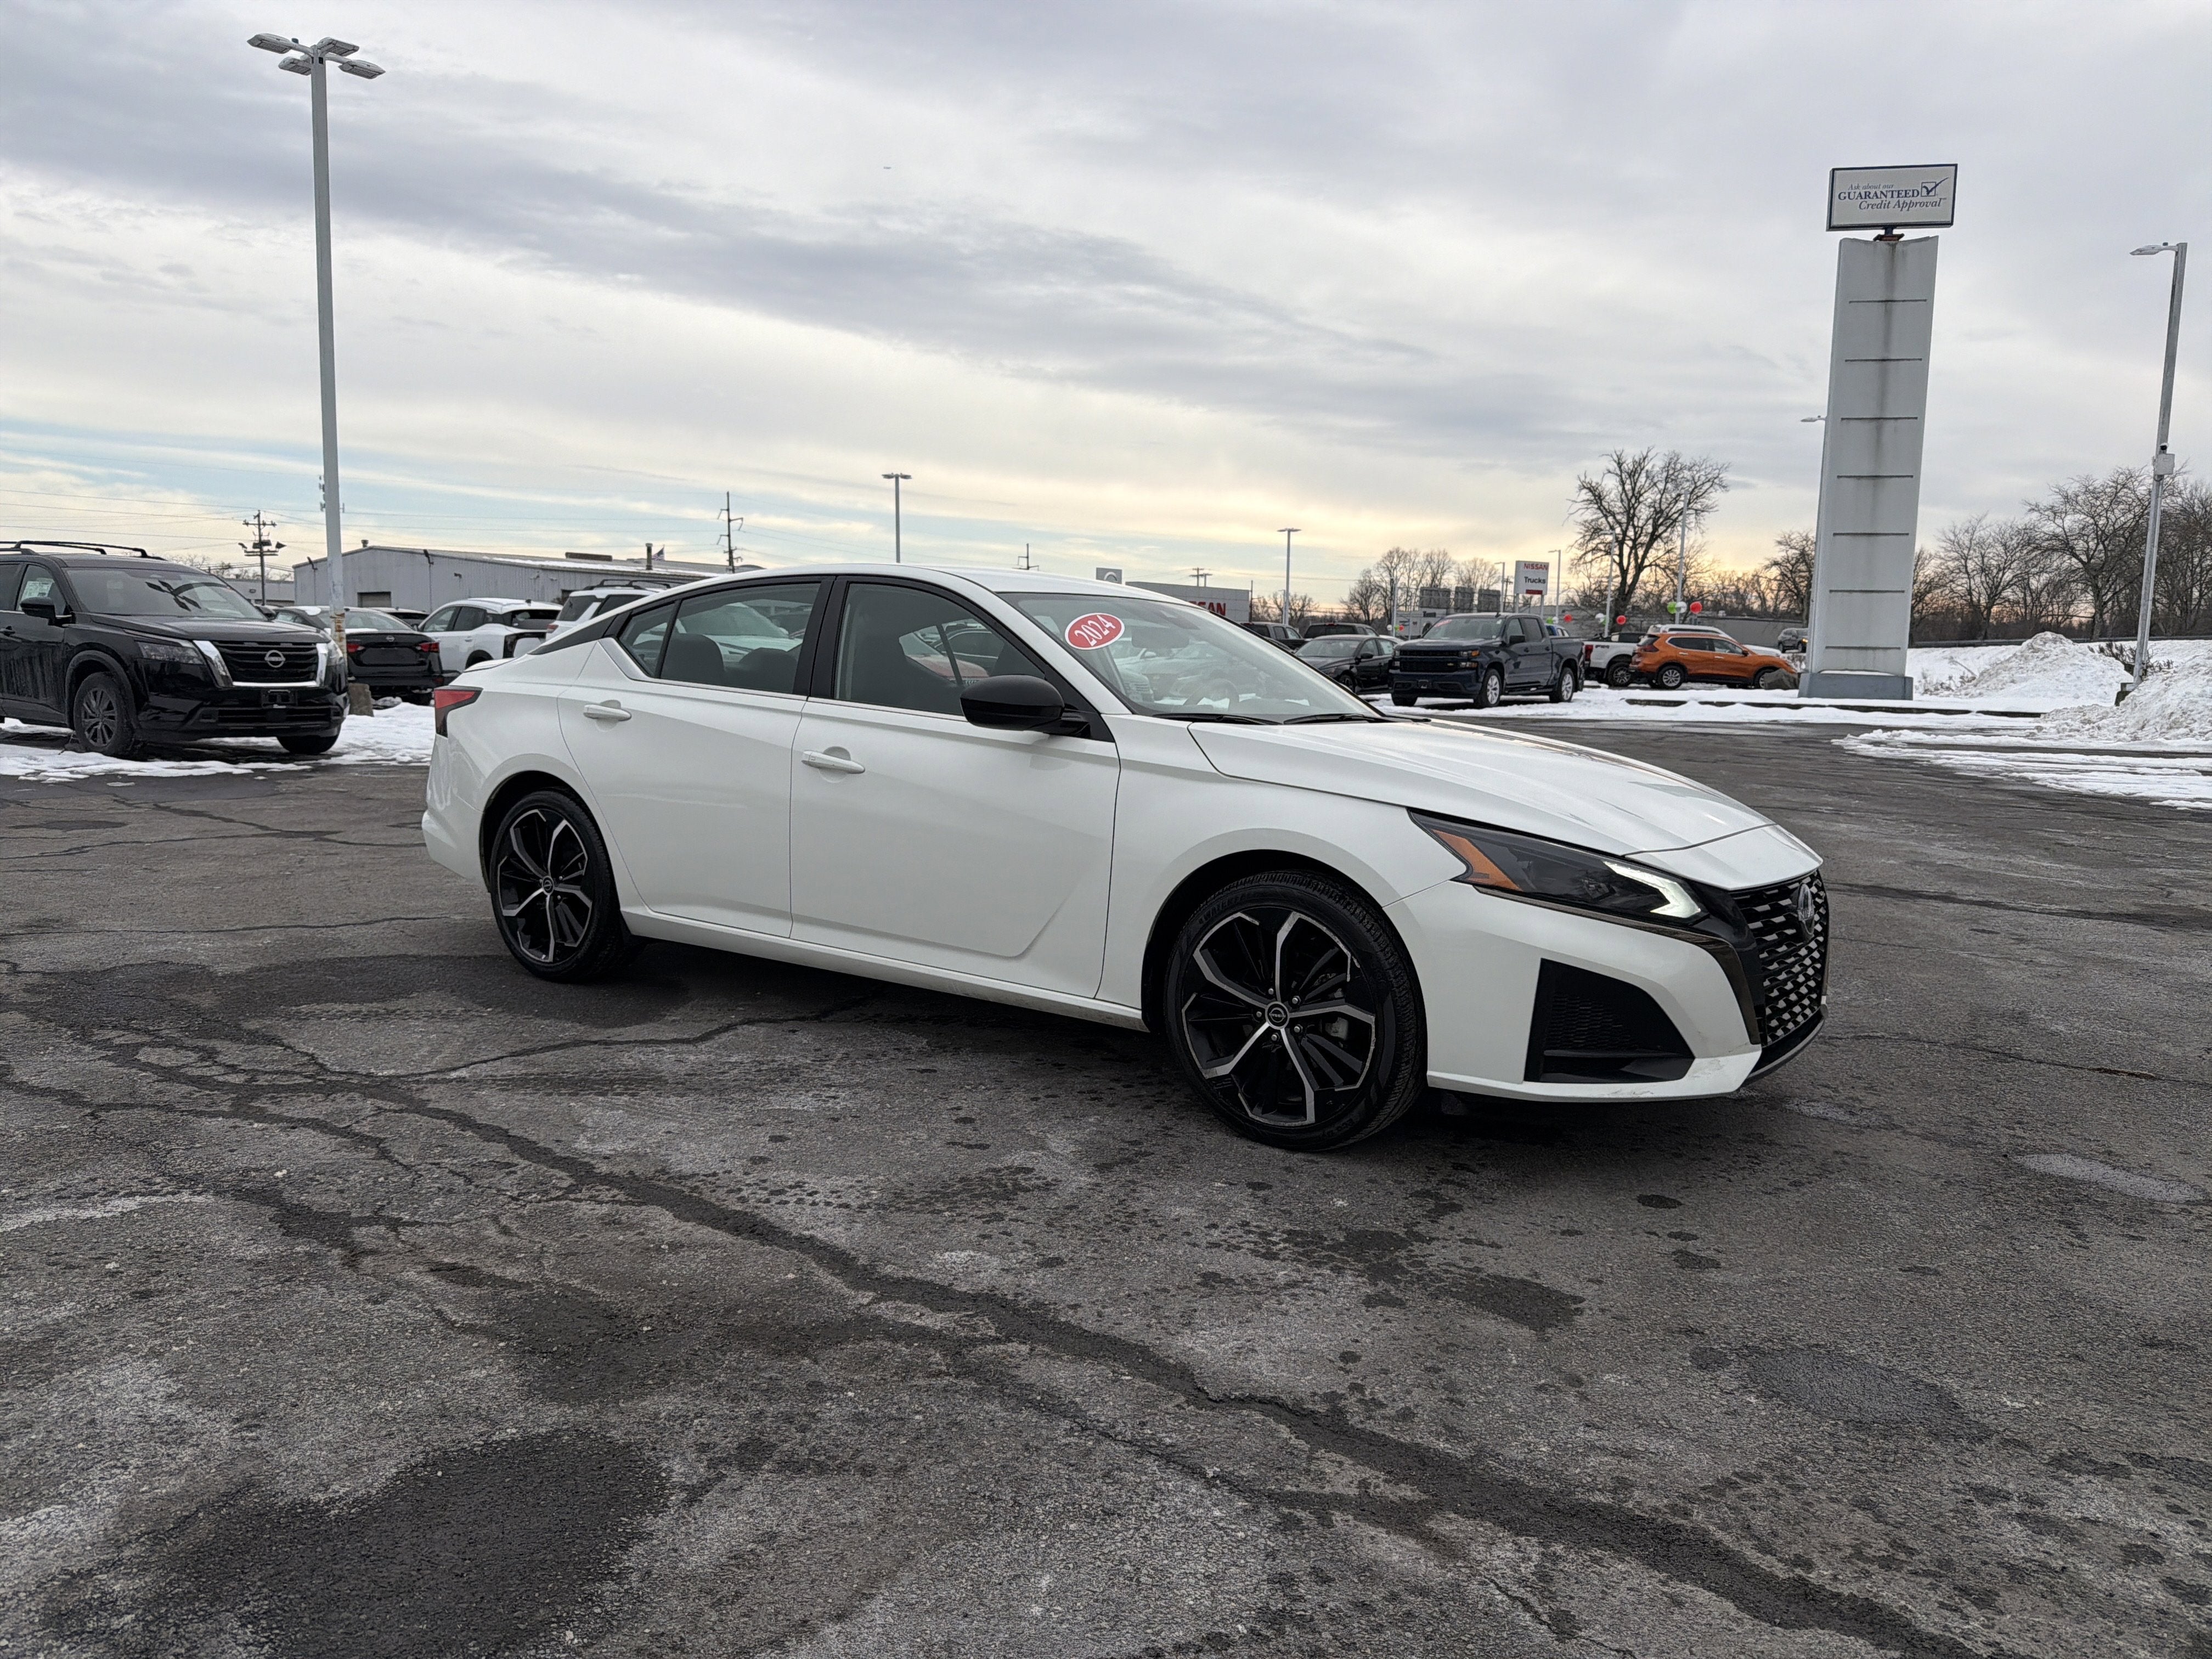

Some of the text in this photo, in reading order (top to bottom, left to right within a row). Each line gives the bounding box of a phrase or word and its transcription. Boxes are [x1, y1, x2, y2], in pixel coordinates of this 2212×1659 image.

[1838, 189, 1920, 200] GUARANTEED
[1858, 199, 1891, 210] Credit
[1074, 614, 1116, 647] 2024
